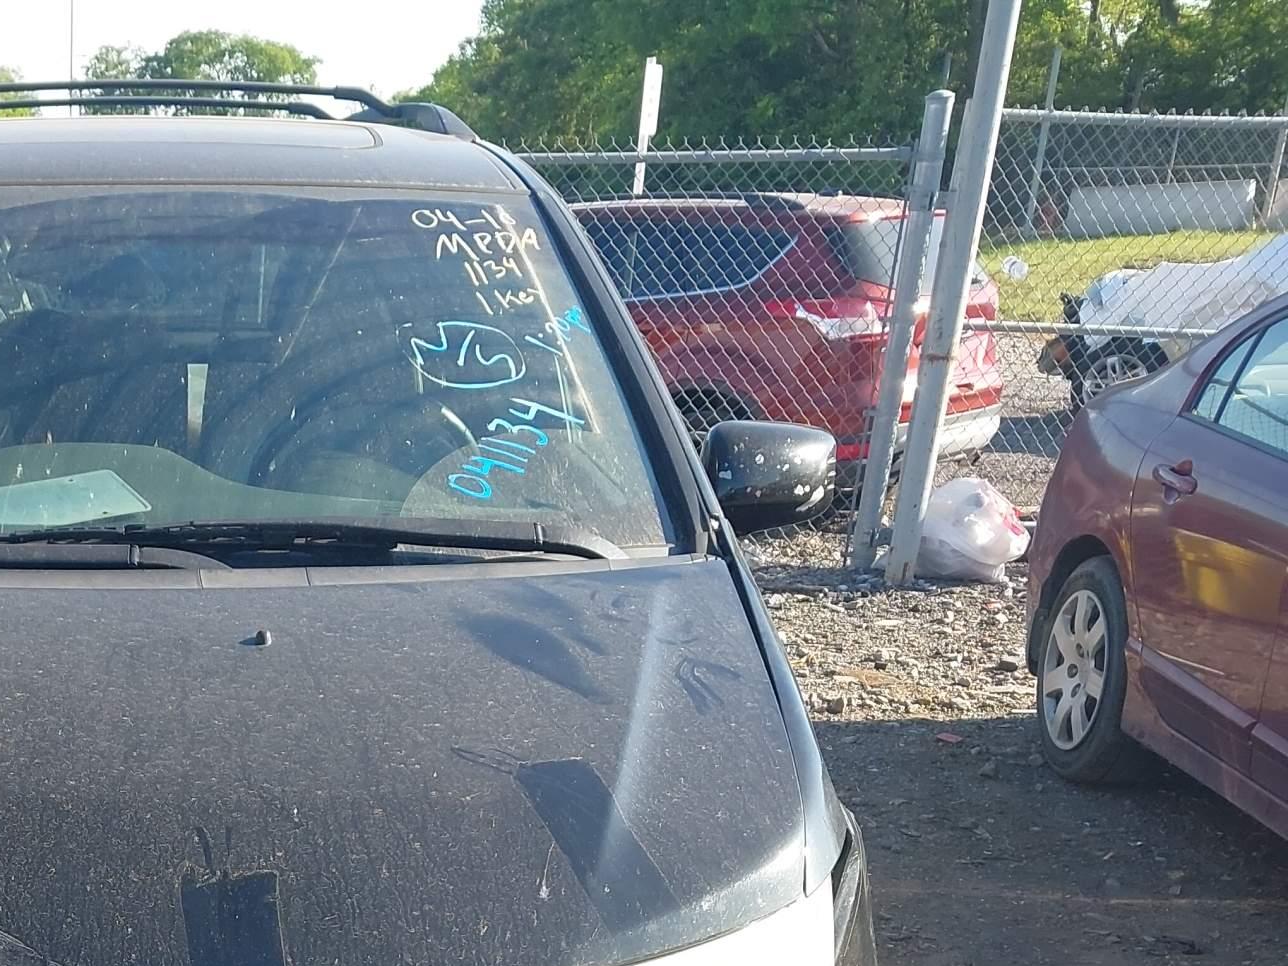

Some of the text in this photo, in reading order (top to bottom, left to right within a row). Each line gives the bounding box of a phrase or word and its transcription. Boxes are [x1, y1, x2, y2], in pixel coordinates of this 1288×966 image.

[464, 257, 522, 286] 1134
[476, 290, 493, 315] 1
[447, 397, 586, 499] 041134
